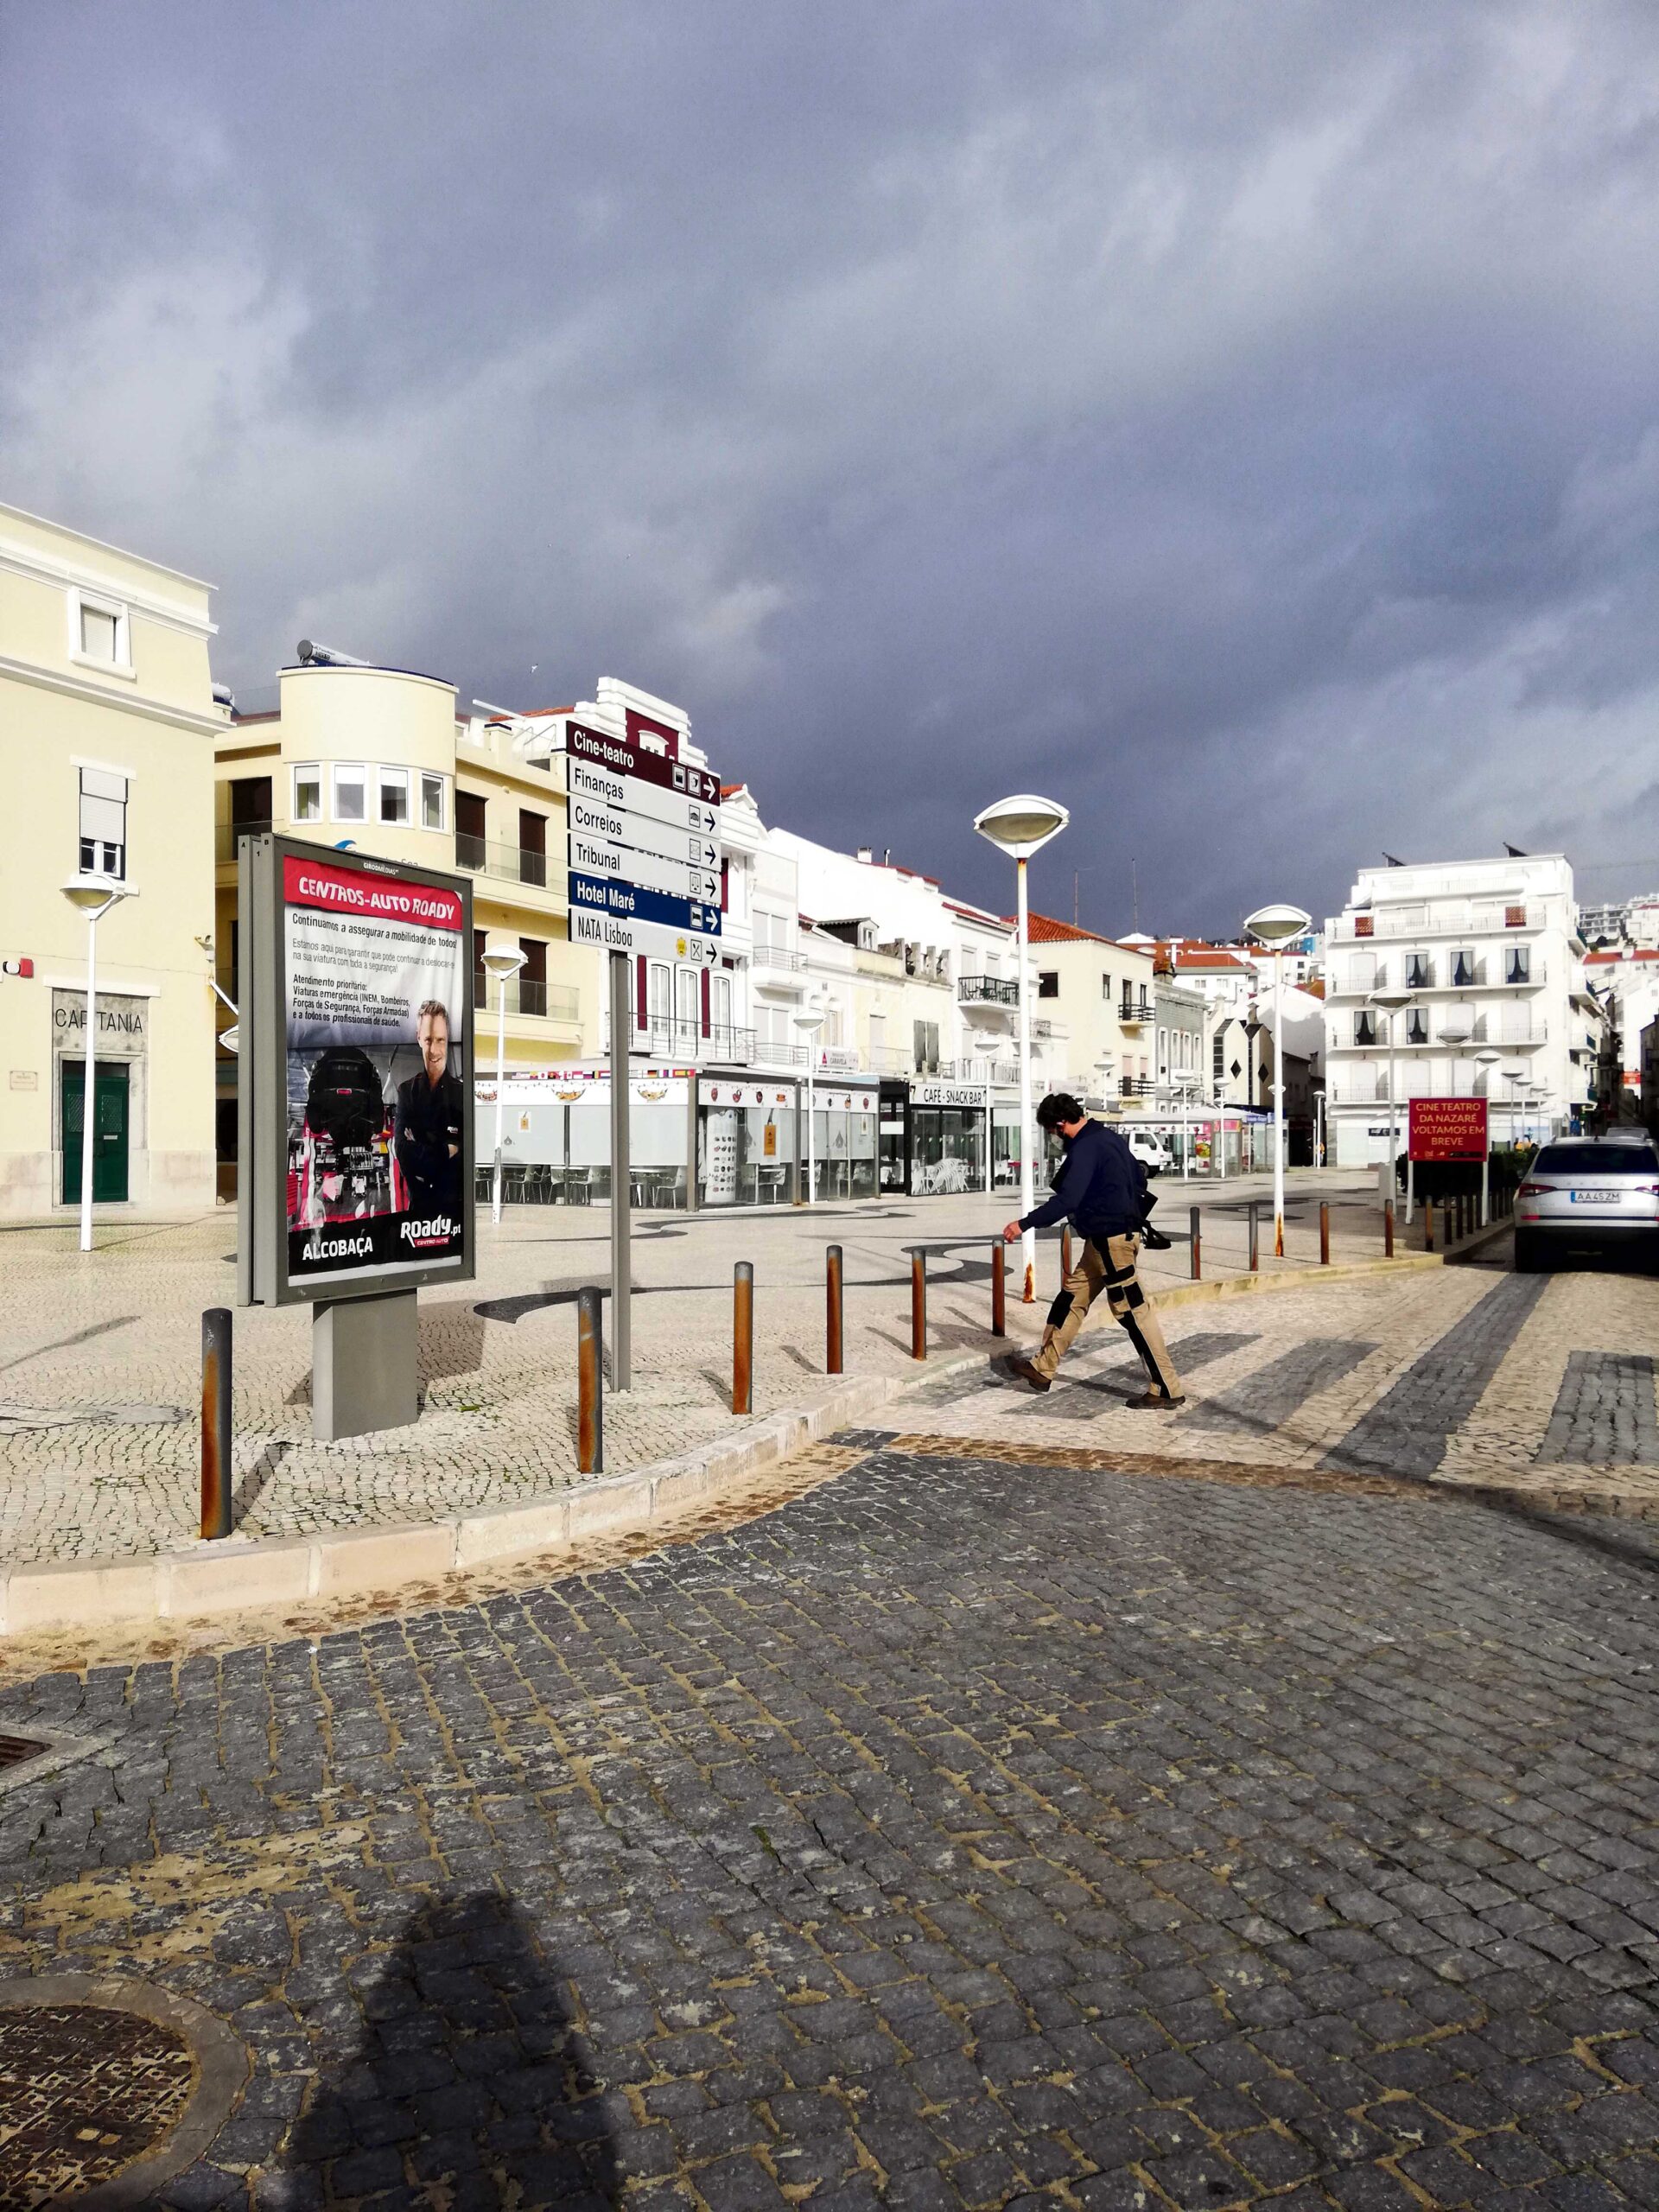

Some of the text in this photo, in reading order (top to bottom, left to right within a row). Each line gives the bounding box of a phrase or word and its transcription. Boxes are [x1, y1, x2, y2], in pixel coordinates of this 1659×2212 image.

[574, 729, 634, 768] Cine-teatro
[574, 767, 624, 800] Finanças
[575, 805, 622, 836] Correios
[576, 842, 620, 871] Tribunal
[299, 877, 455, 920] CENTROS-AUTO ROADY
[577, 880, 635, 911] Hotel Maré
[292, 913, 339, 931] Continuamos
[341, 924, 346, 932] a
[348, 925, 384, 938] assegurar
[391, 931, 426, 944] mobilidade
[427, 934, 436, 945] de
[439, 937, 457, 949] todos!
[577, 918, 632, 947] NATA Lisboa
[292, 938, 319, 951] Estamos
[321, 942, 334, 953] aqui
[335, 946, 347, 955] para
[347, 948, 370, 958] garantir
[371, 951, 381, 960] que
[382, 952, 395, 962] pode
[293, 952, 301, 960] na
[313, 954, 336, 965] viatura
[337, 958, 349, 966] com
[350, 959, 362, 968] toda
[293, 974, 367, 991] Atendimento prioritário:
[293, 986, 410, 1007] Viaturas emergência (INEM, Bombeiros,
[293, 998, 409, 1018] Forças de Segurança, Forças Armadas)
[55, 1008, 143, 1033] CAPTANIA
[305, 1011, 322, 1020] todos
[323, 1014, 330, 1022] os
[332, 1014, 372, 1024] profissionais
[373, 1017, 380, 1025] de
[381, 1017, 401, 1027] saúde.
[924, 1086, 941, 1103] CAFÉ
[946, 1090, 968, 1104] SNACK
[969, 1091, 982, 1105] BAR
[1416, 1103, 1481, 1111] CINE TEATRO
[1419, 1113, 1477, 1123] DA NAZARÉ
[1412, 1126, 1485, 1134] VOLTAMOS EM
[1431, 1137, 1464, 1145] BREVE
[302, 1237, 373, 1260] ALCOBAÇA
